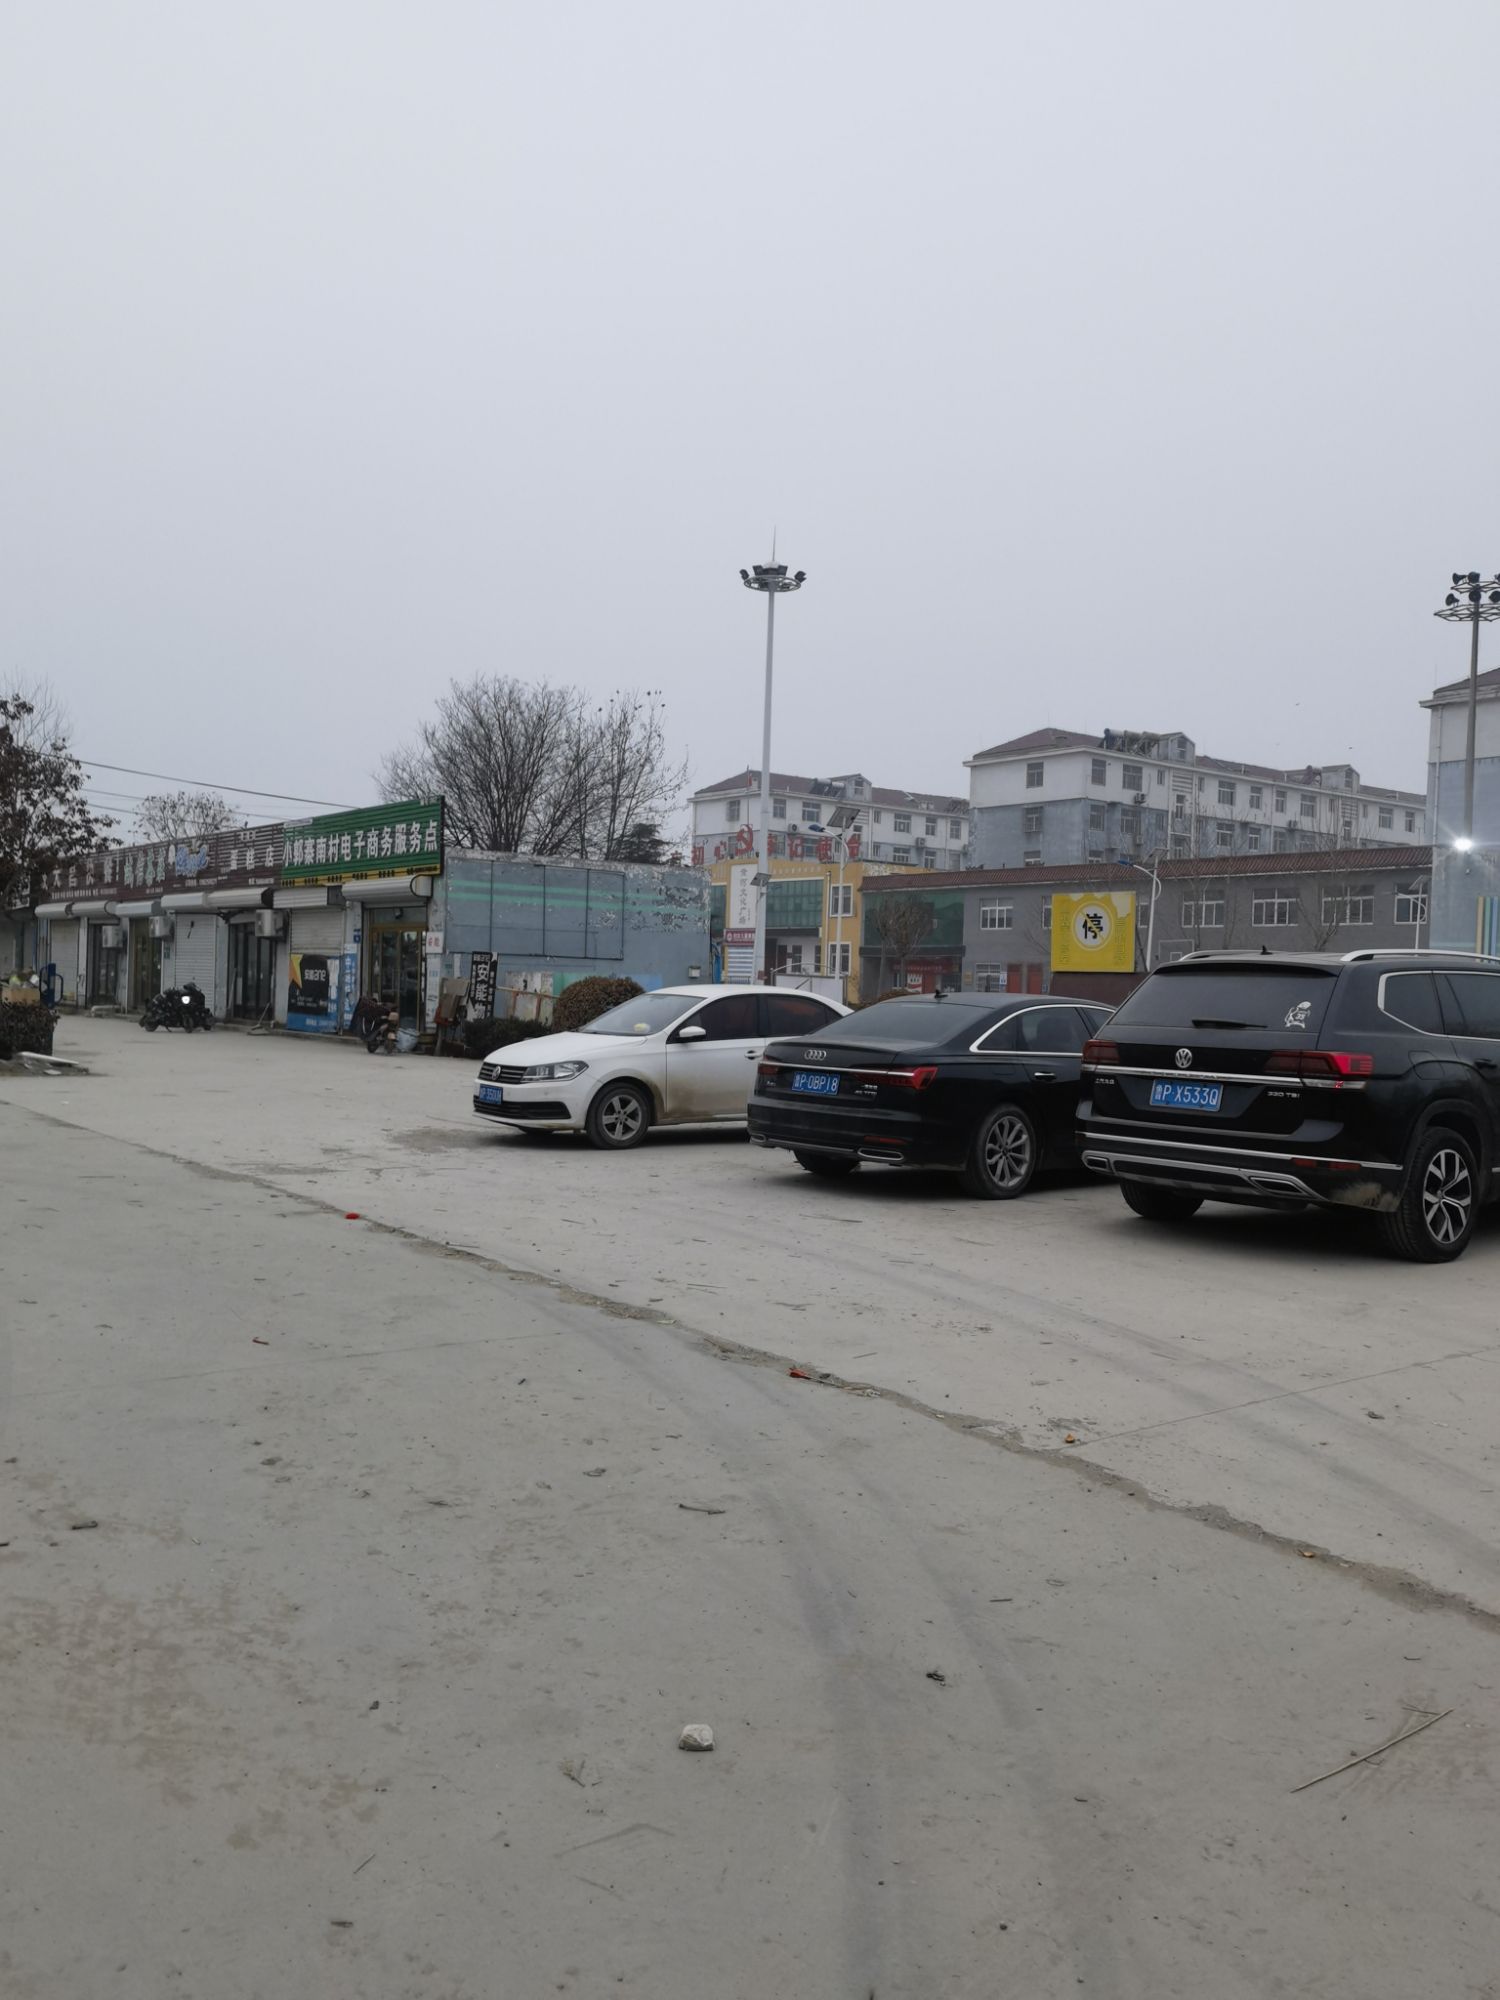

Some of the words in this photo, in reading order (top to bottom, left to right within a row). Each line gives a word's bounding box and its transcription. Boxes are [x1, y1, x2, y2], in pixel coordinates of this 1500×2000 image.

[283, 819, 438, 868] 小郭寨南村电子商务服务点
[1082, 913, 1104, 940] 停
[1154, 1083, 1219, 1107] 鲁P·X533Q
